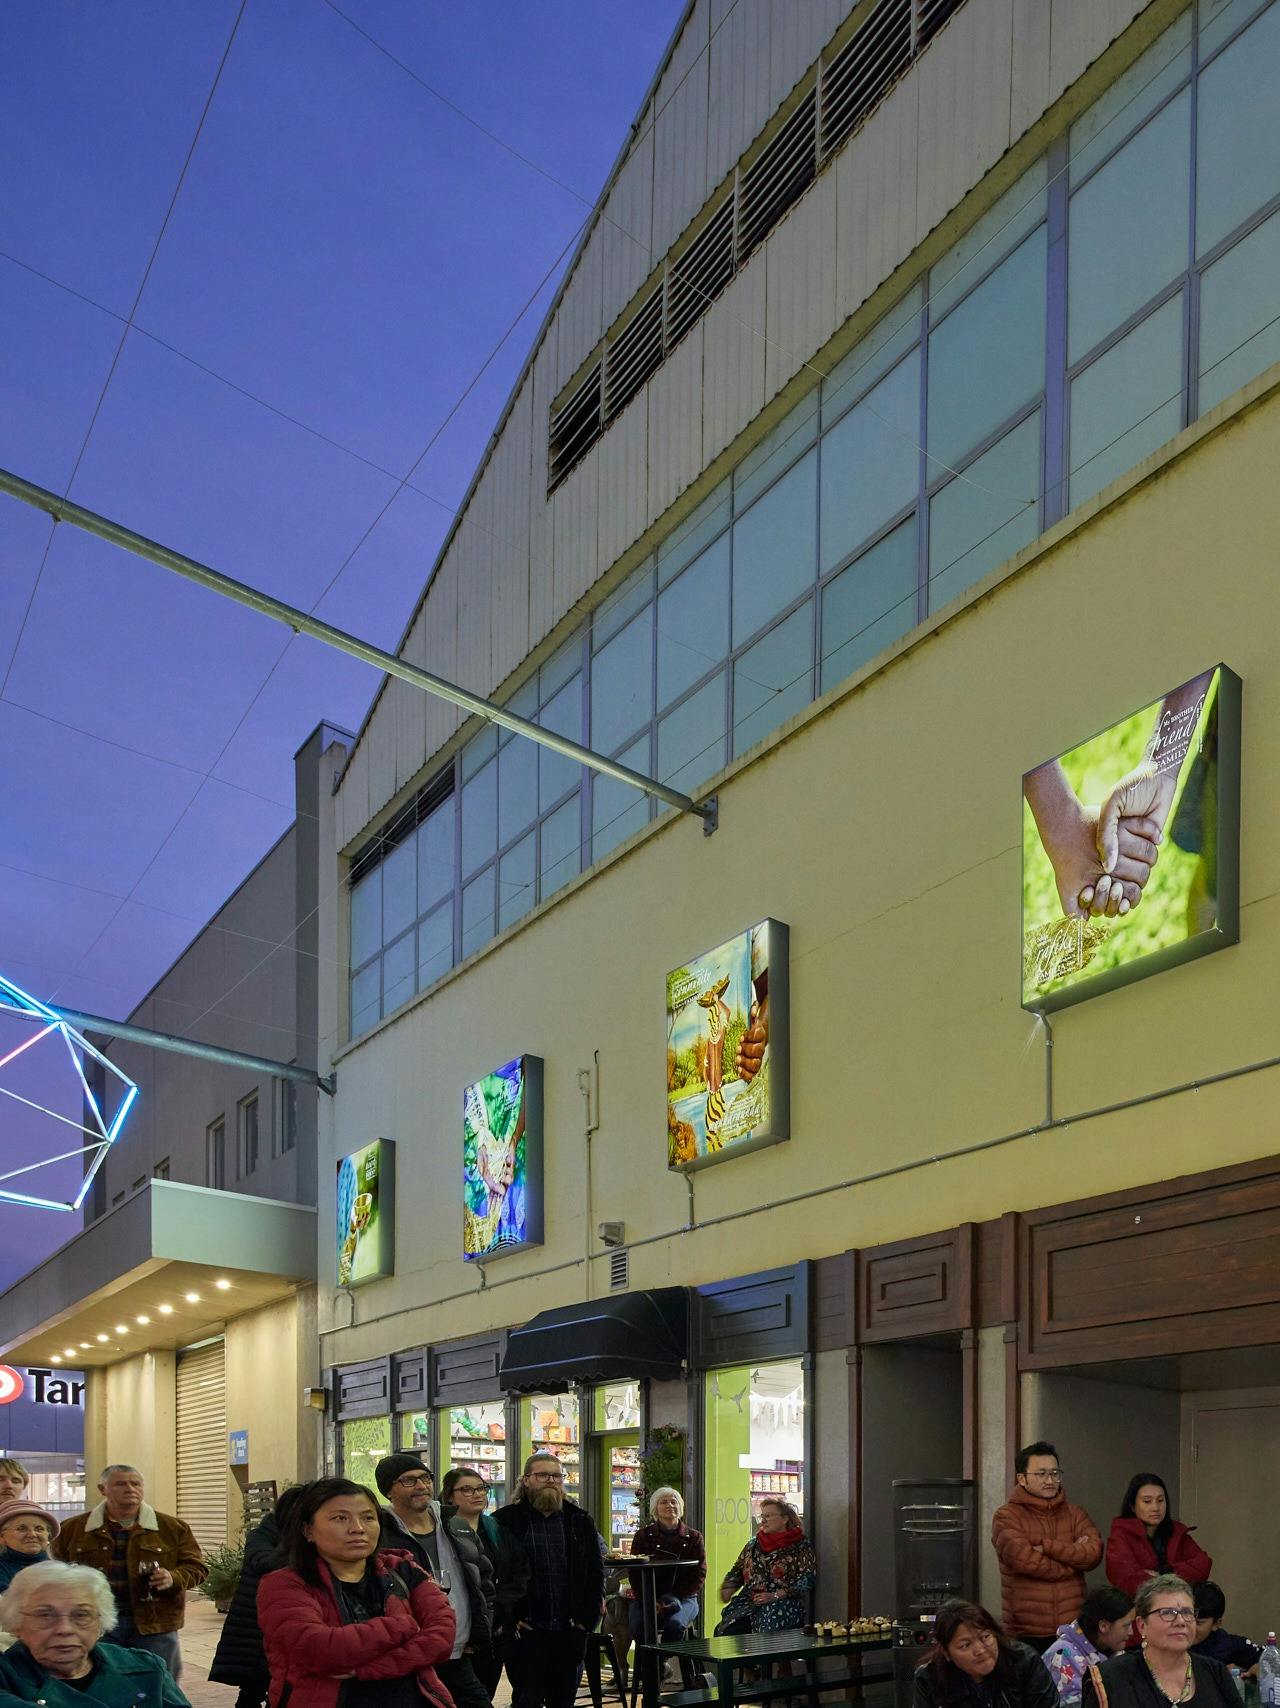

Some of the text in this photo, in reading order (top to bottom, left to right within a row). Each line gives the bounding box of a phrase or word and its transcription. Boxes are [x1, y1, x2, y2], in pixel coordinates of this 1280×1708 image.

[1171, 706, 1193, 722] BROTHER
[1130, 693, 1205, 790] friend
[1155, 746, 1188, 769] FAMILY
